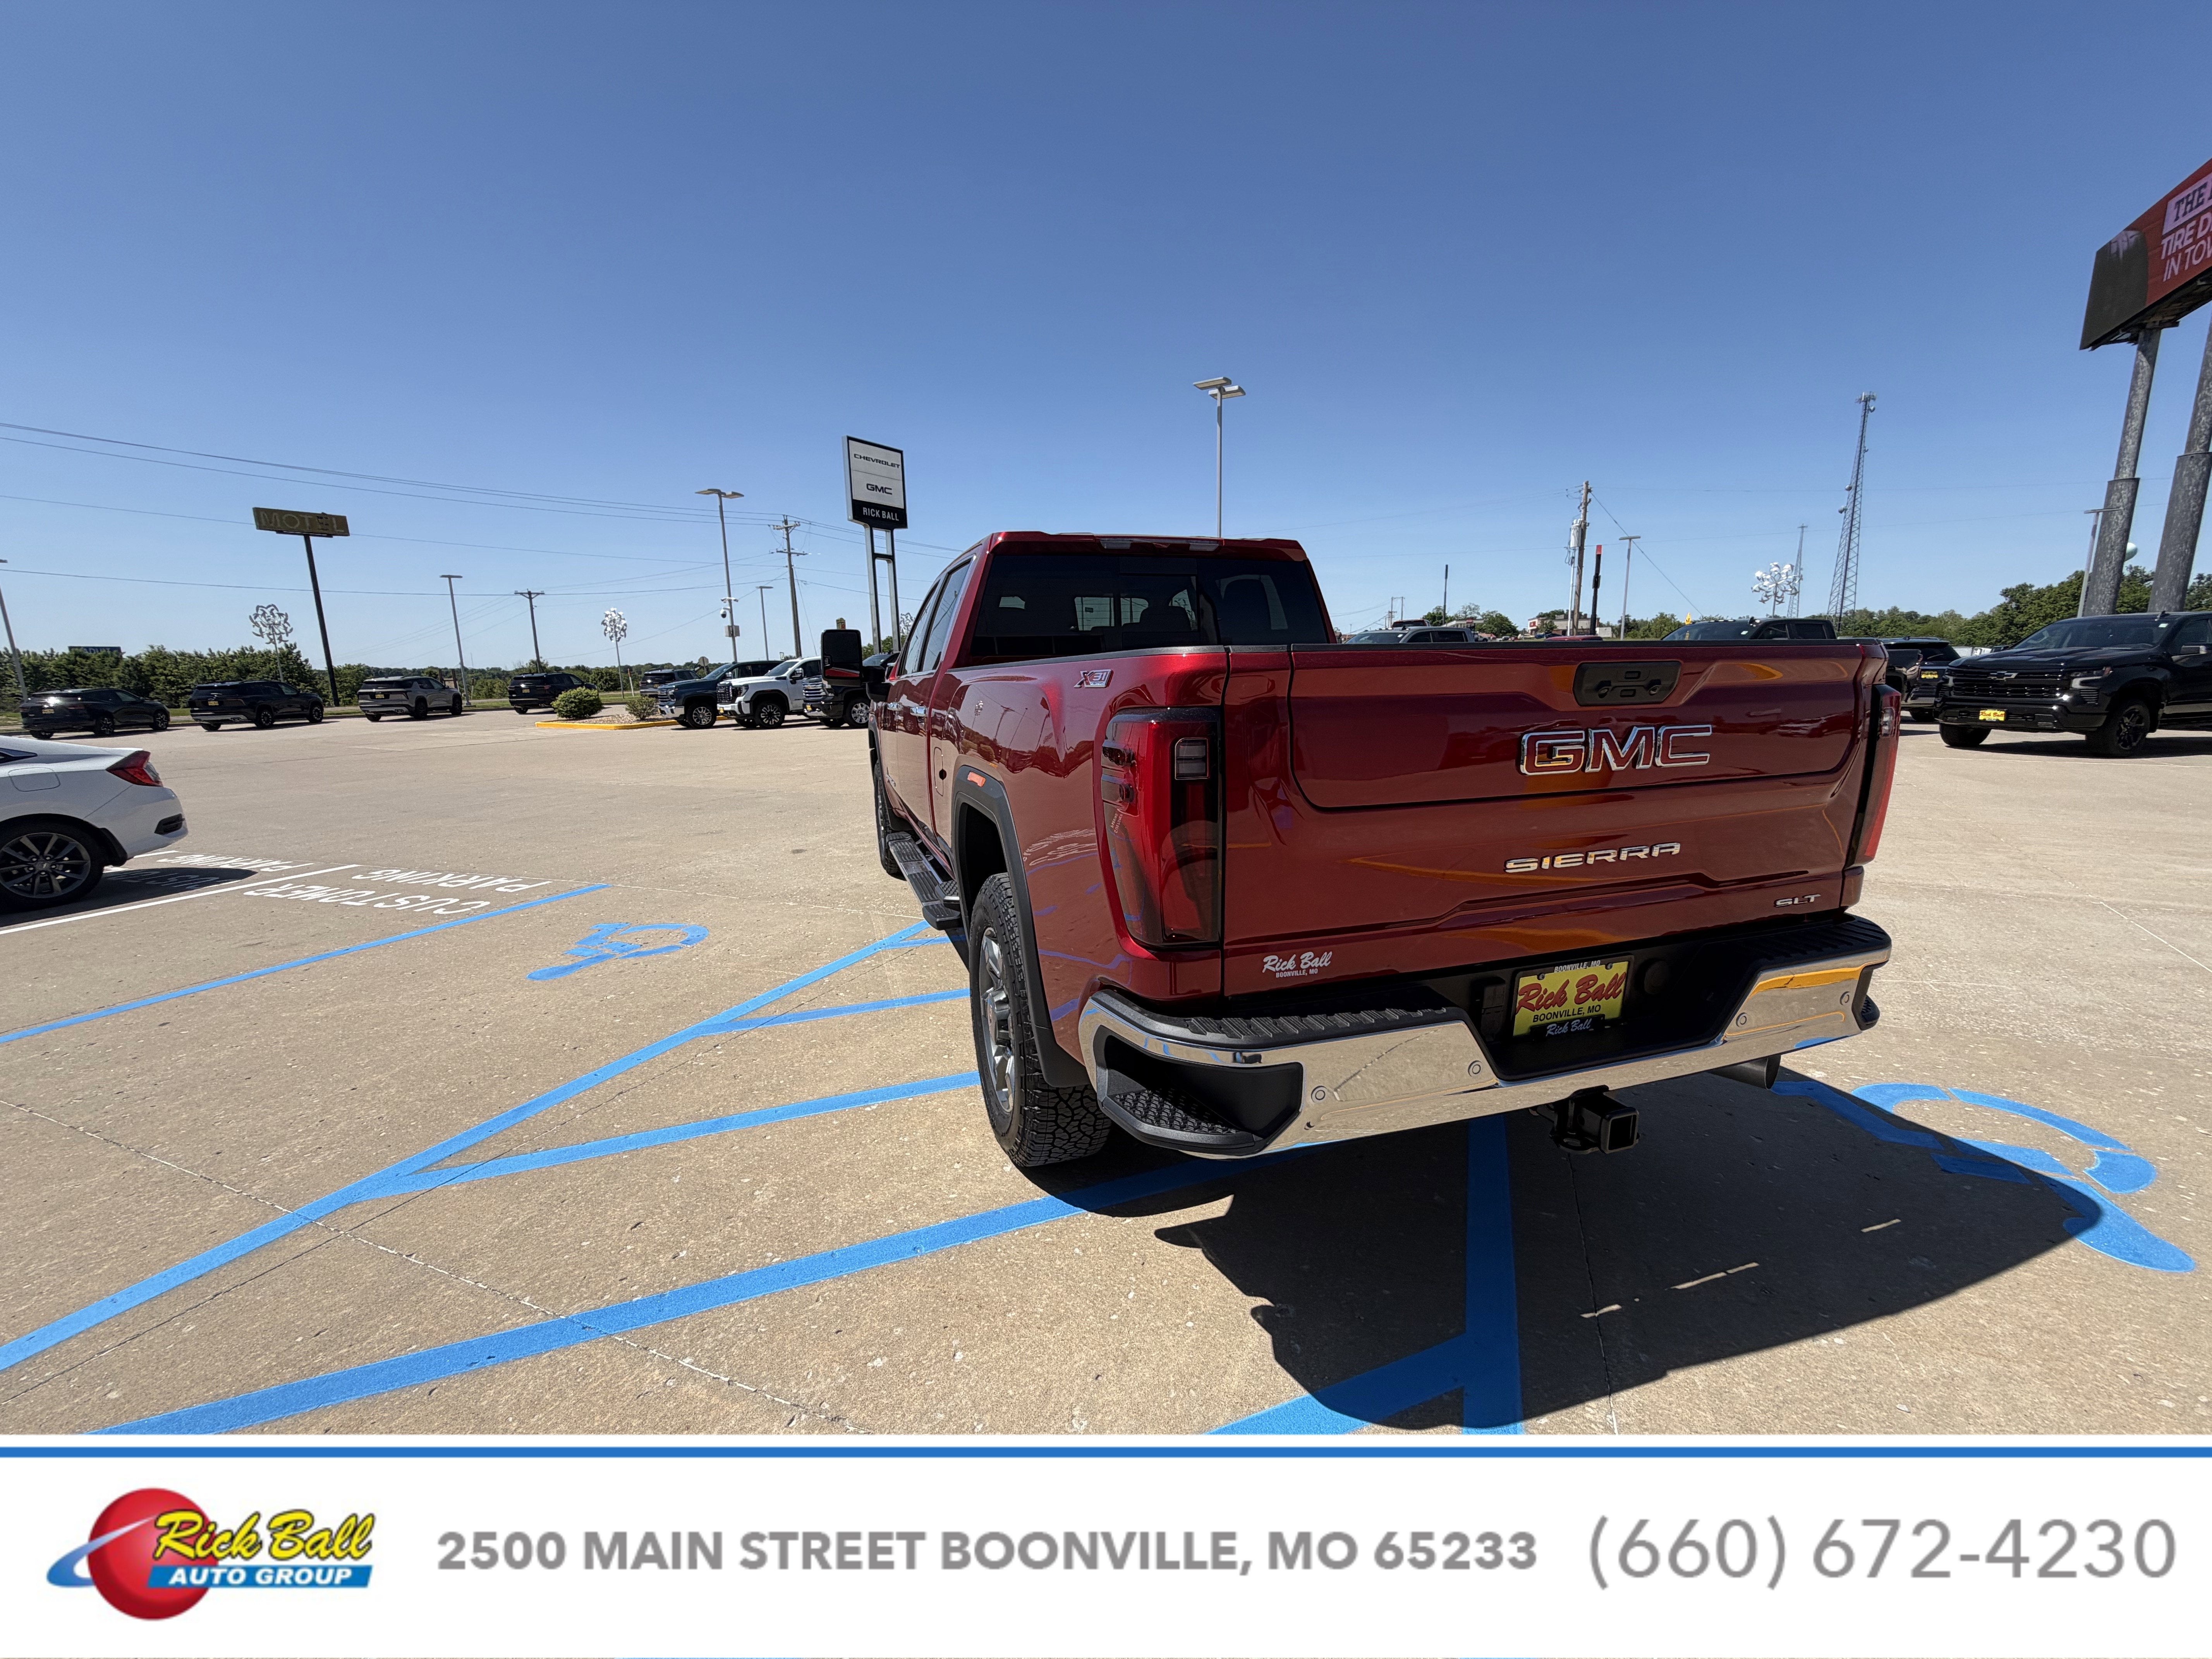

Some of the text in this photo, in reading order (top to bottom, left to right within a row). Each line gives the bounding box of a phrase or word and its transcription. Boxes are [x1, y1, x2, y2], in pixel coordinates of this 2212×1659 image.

[2173, 182, 2207, 222] THE
[2160, 211, 2212, 260] TIRE D
[2163, 252, 2182, 282] IN
[854, 453, 900, 469] CHEVROLET
[866, 483, 892, 495] GMC
[260, 511, 344, 532] MOTEL
[863, 507, 899, 521] RICK BALL
[1073, 669, 1111, 688] X31
[1520, 724, 1712, 775] GMC
[156, 854, 315, 872] PARKING
[1505, 842, 1681, 873] SIERRA
[352, 869, 553, 892] PARKING
[243, 883, 490, 914] CUSTOMER
[1775, 894, 1821, 907] SLT
[1262, 951, 1332, 973] Rick Ball
[1554, 962, 1588, 973] BOONVILLE,
[1276, 969, 1307, 978] BOONVILLE,
[1516, 972, 1626, 1015] Rick Ball
[1532, 1005, 1601, 1023] BOONVILLE, MO
[1546, 1018, 1592, 1037] Rick Ball
